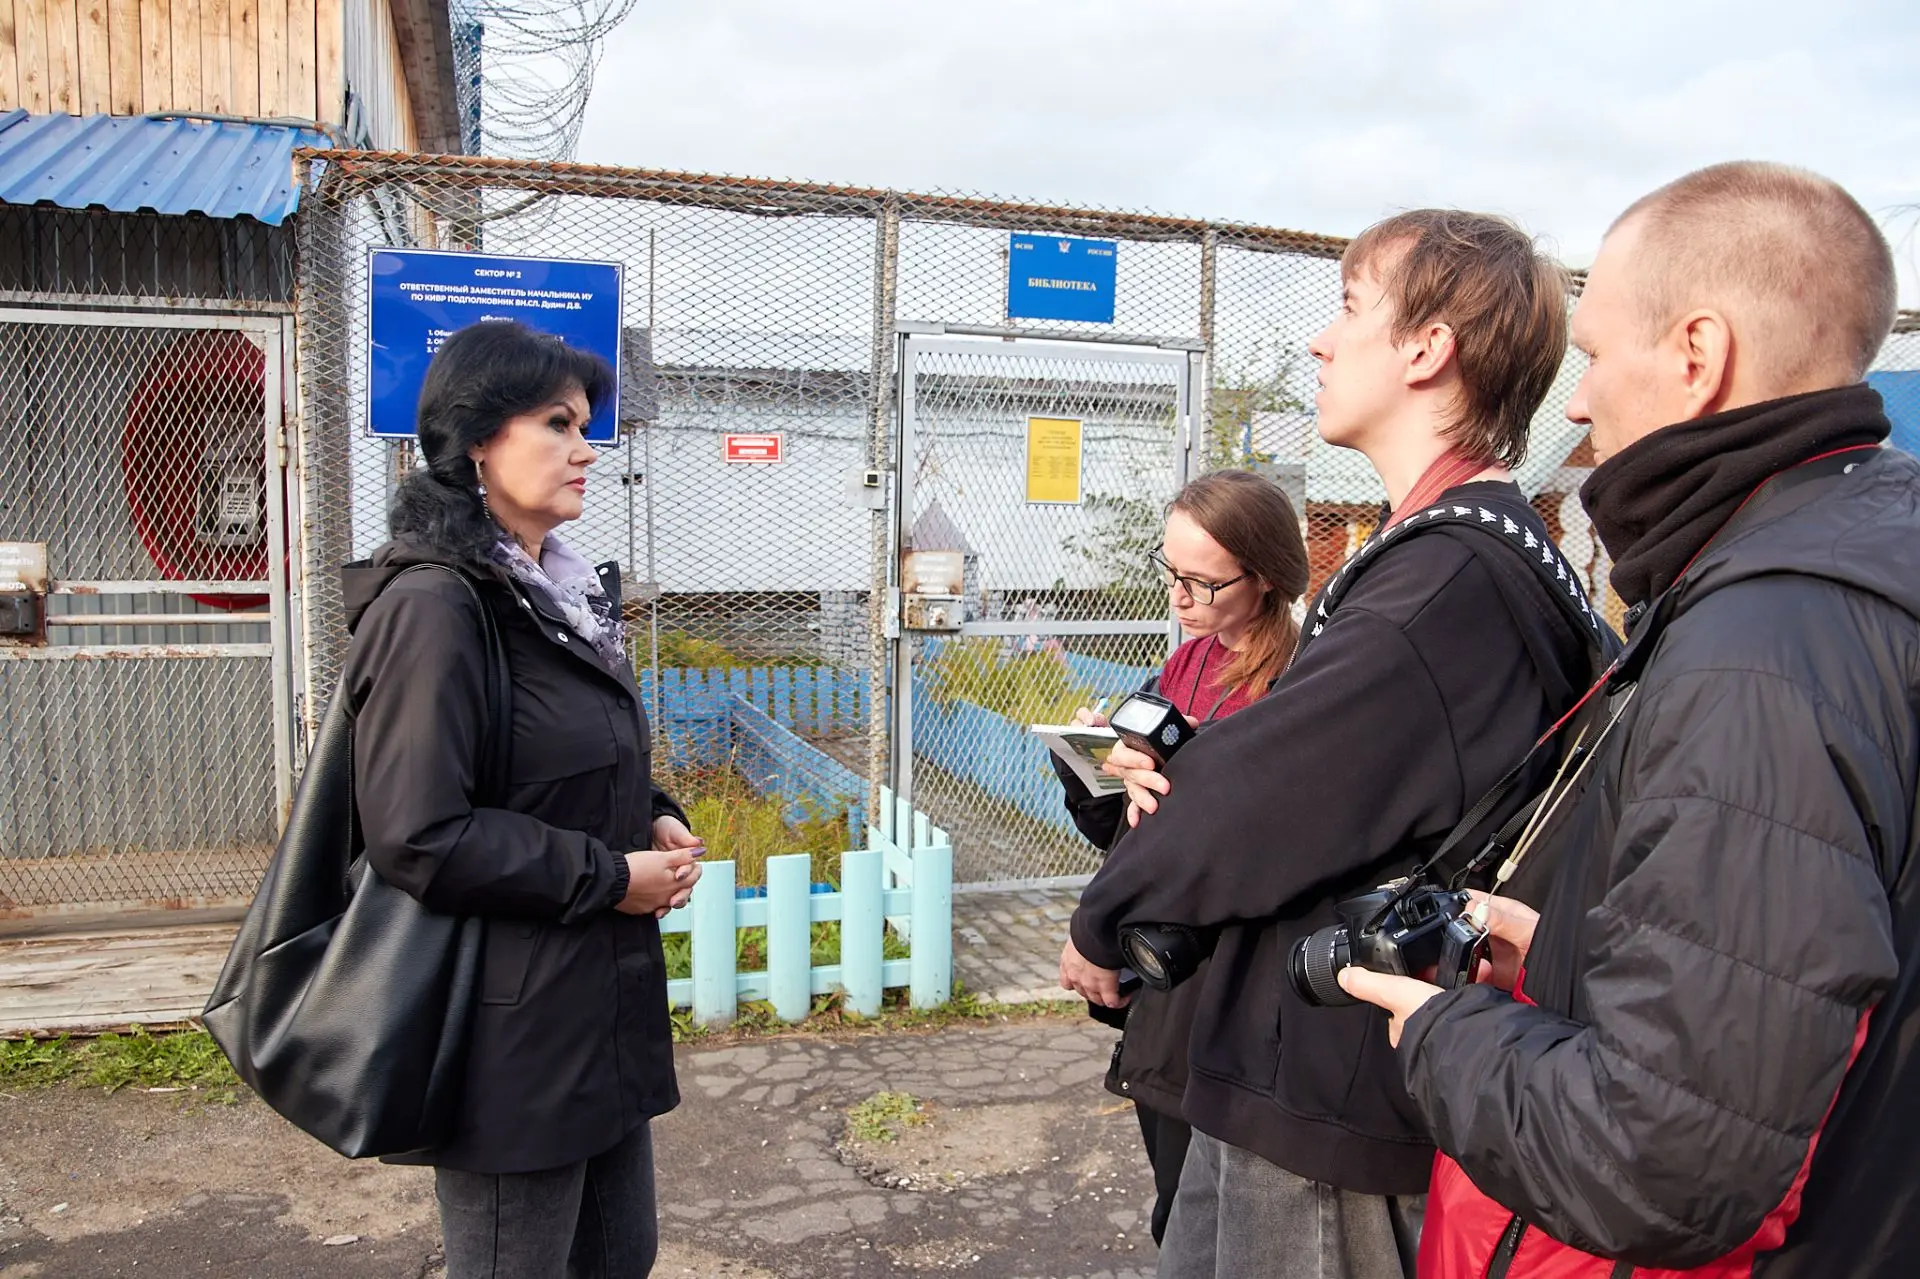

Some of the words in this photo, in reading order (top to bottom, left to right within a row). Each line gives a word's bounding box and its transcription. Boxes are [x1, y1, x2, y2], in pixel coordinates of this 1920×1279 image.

[474, 268, 505, 278] СЕКТОР
[506, 270, 515, 279] №
[516, 271, 521, 279] 2
[1028, 277, 1097, 291] БИБЛИОТЕКА
[400, 282, 469, 294] ОТВЕТСТВЕННЫЙ
[470, 286, 526, 297] ЗАМЕСТИТЕЛЬ
[527, 290, 581, 300] НАЧАЛЬНИКА
[581, 292, 593, 301] ИУ
[411, 293, 424, 301] ПО
[447, 295, 514, 306] ПОДПОЛКОВНИК
